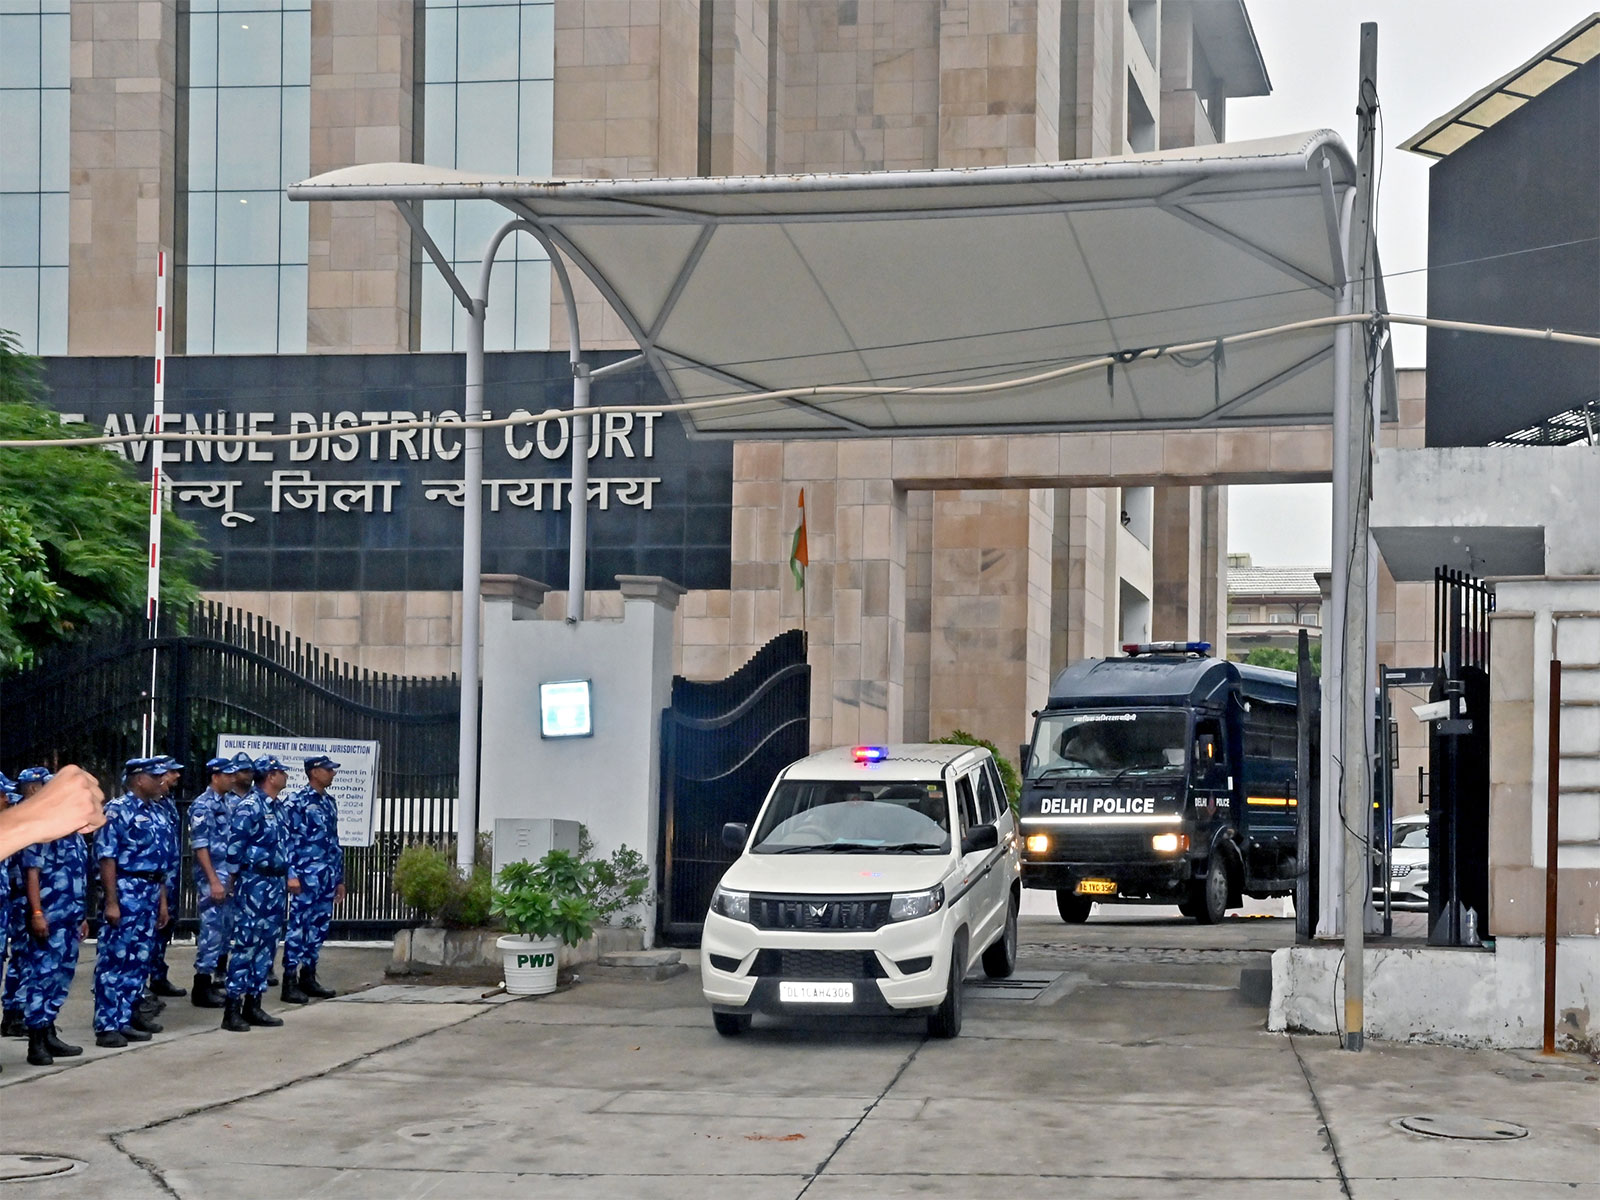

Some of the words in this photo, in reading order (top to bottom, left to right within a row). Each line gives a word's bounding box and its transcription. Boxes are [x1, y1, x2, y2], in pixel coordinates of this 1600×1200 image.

[289, 409, 492, 462] DISTRIC
[264, 469, 401, 513] जिला
[224, 740, 246, 749] ONLINE
[247, 740, 261, 750] FINE
[262, 741, 290, 751] PAYMENT
[290, 742, 298, 751] IN
[298, 743, 328, 753] CRIMINAL
[329, 744, 371, 754] JURISDICTION
[1040, 797, 1088, 814] DELHI
[1092, 797, 1156, 814] POLICE
[1194, 797, 1208, 807] DELHI
[1215, 797, 1230, 808] POLICE
[516, 953, 555, 969] PWD
